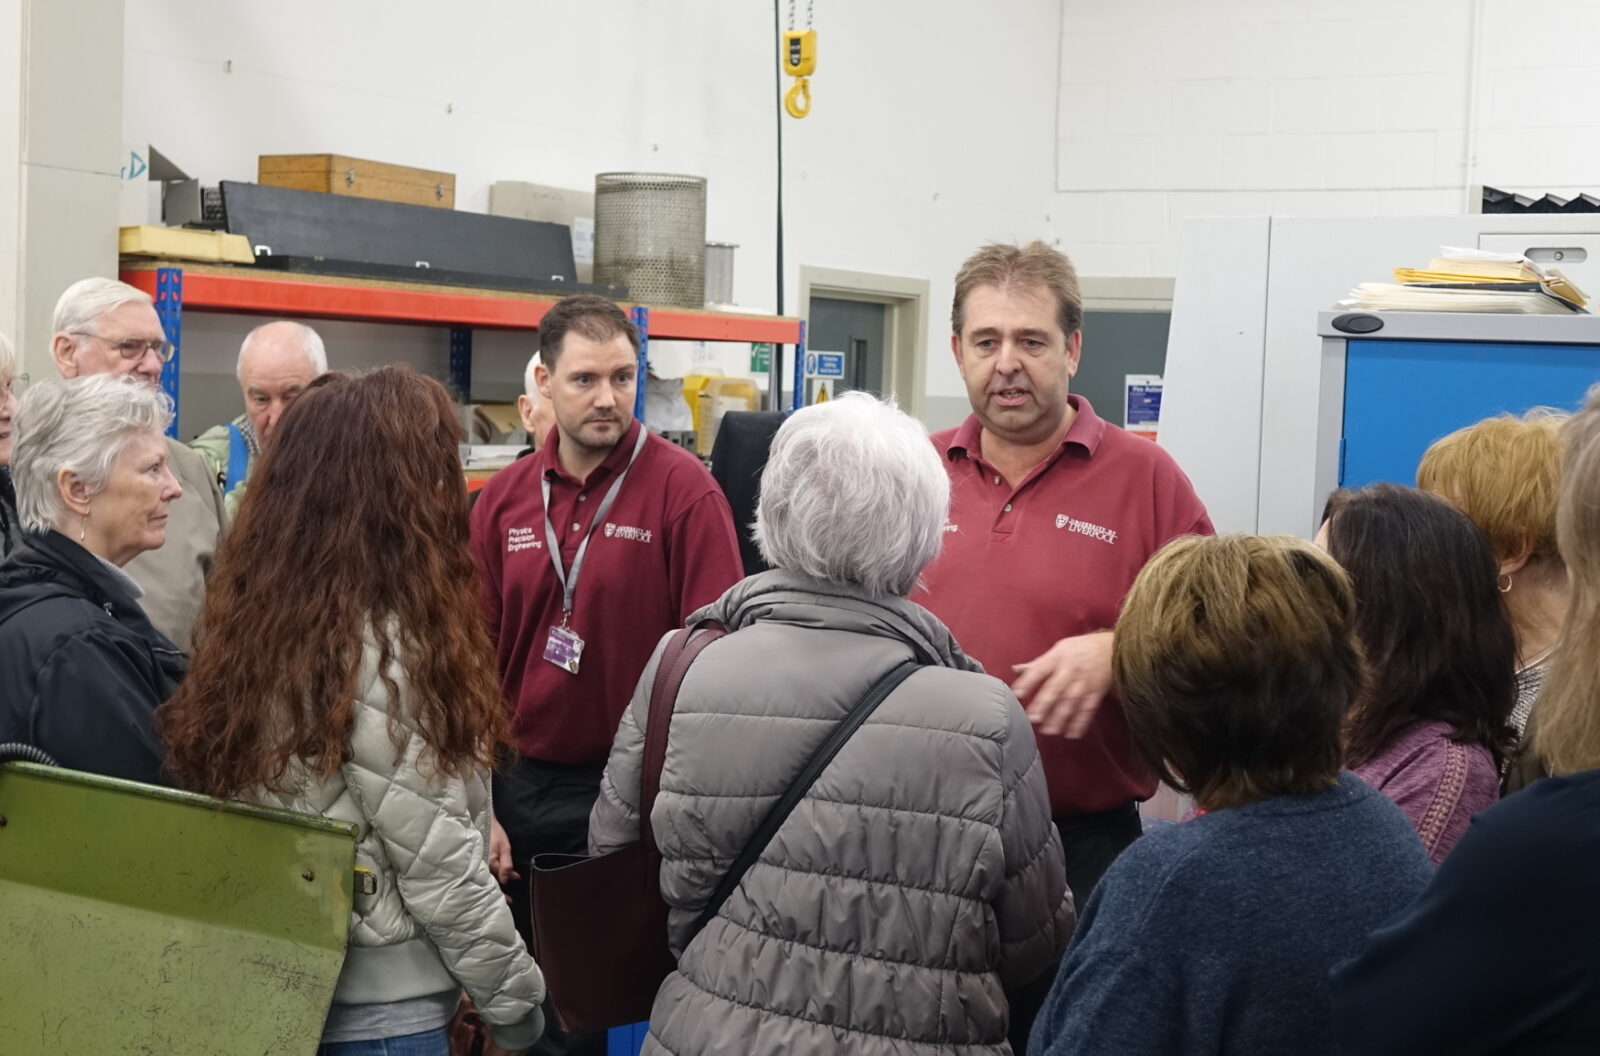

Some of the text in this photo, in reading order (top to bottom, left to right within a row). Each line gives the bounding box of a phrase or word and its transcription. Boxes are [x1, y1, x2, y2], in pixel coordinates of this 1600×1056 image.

[508, 528, 532, 536] Physics
[508, 534, 536, 544] Precision
[507, 541, 542, 552] Engineering
